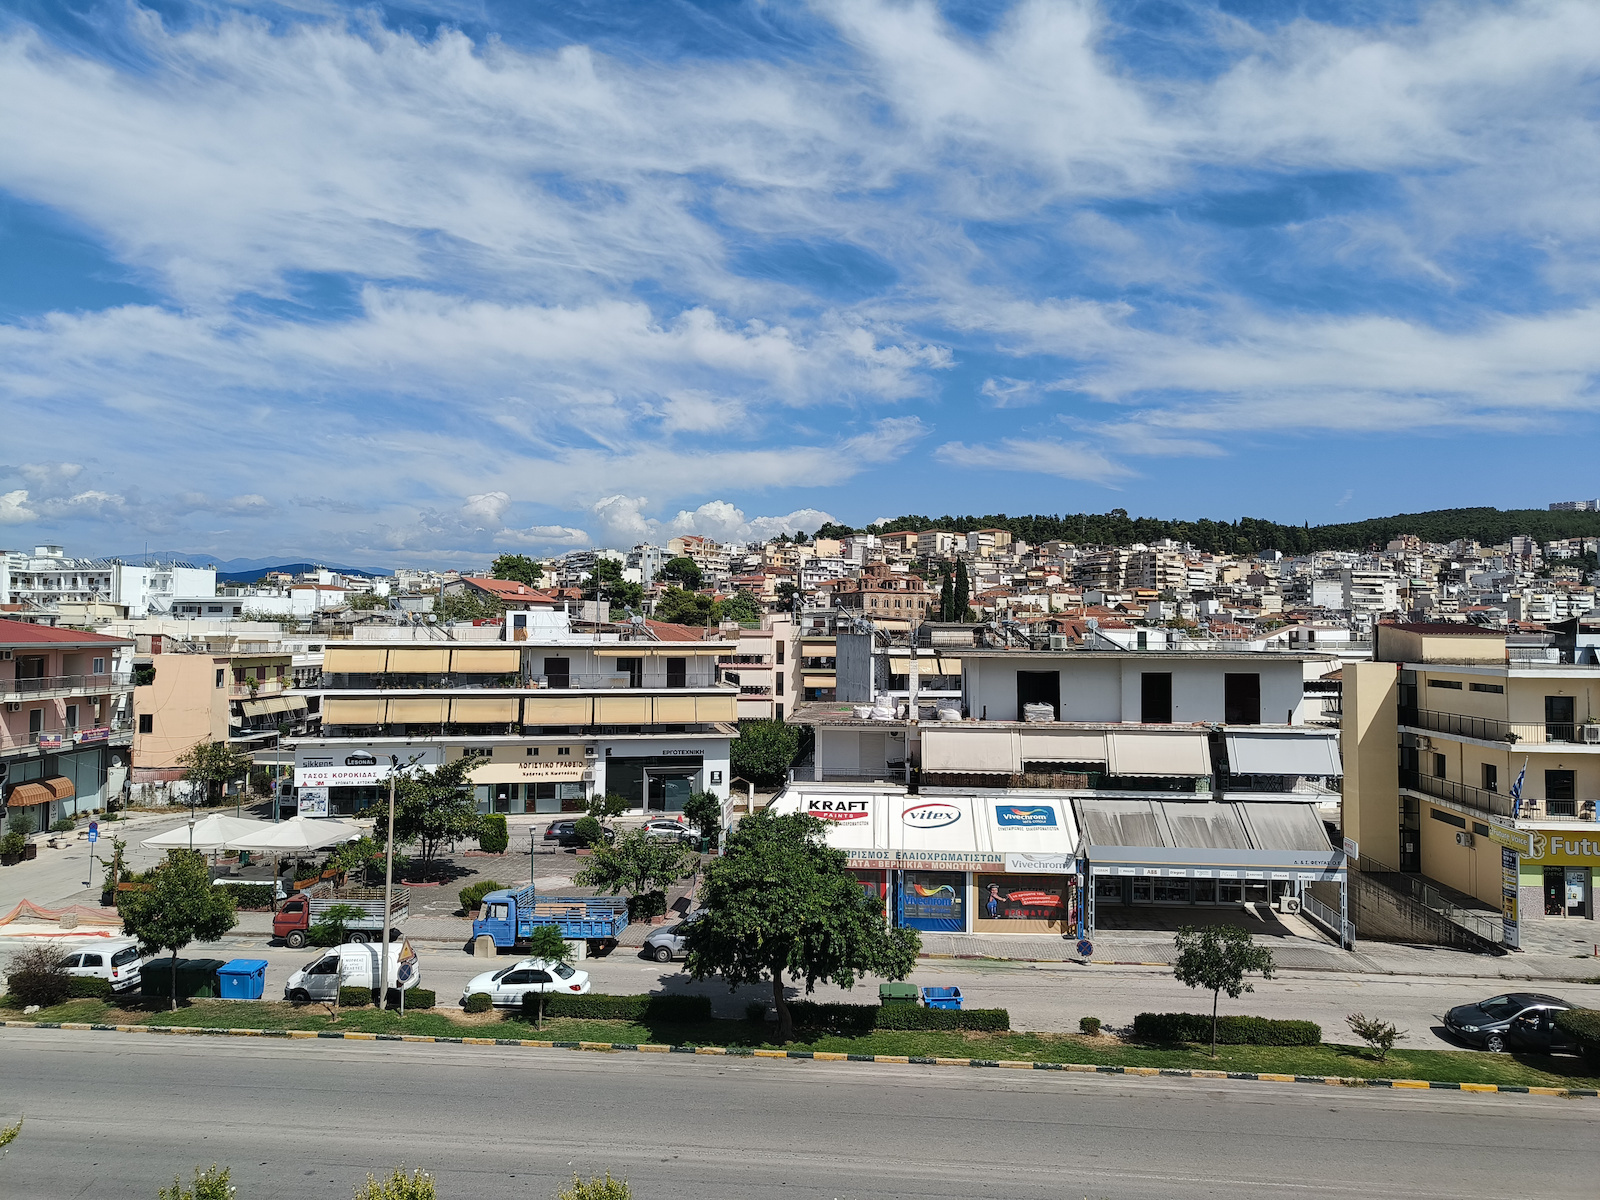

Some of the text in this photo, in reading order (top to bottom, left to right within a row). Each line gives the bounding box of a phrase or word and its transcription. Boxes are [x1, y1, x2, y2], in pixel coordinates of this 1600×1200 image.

[809, 800, 869, 811] KRAFT
[910, 810, 954, 820] vitex
[1511, 833, 1528, 846] Voice
[895, 851, 1002, 862] ΕΛΑΙΟΧΡΩΜΑΤΙΣΤΩΝ
[878, 860, 923, 869] ΒΕΡΝΙΚΙΑ
[931, 862, 983, 871] ΜΟΝΩΤΙΚΑ
[1011, 860, 1067, 869] Vivechrom
[904, 894, 952, 906] Vivechrom
